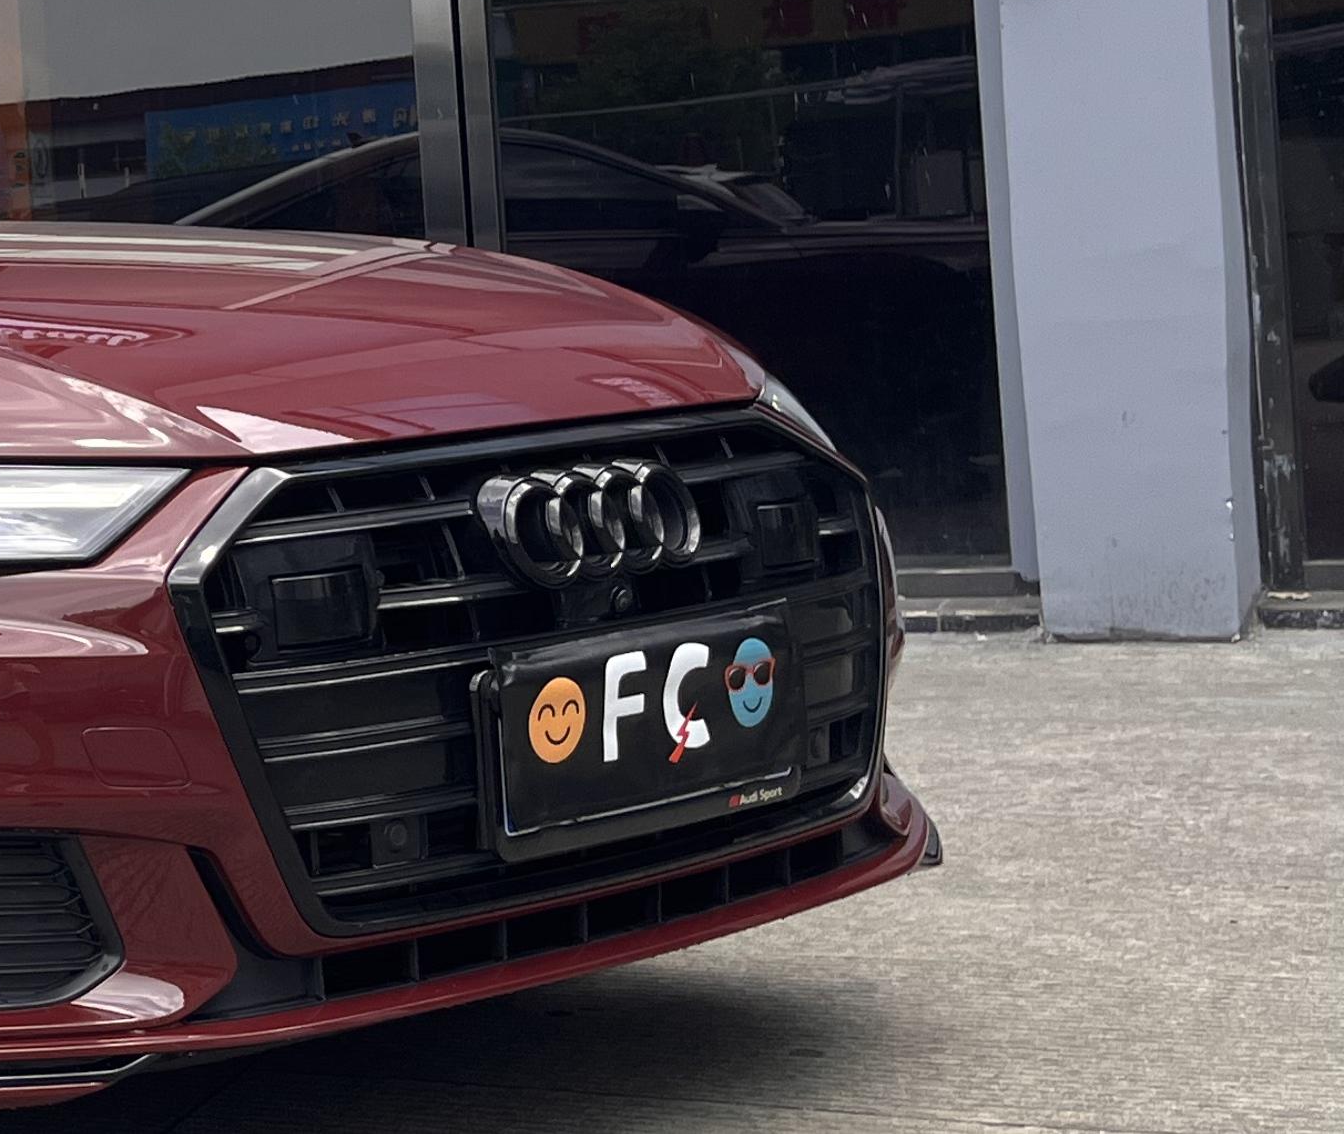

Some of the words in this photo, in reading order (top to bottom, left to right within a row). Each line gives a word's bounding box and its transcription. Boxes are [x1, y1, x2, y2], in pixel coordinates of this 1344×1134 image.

[603, 642, 711, 762] FC
[739, 790, 758, 806] Audi
[759, 786, 783, 802] Sport
